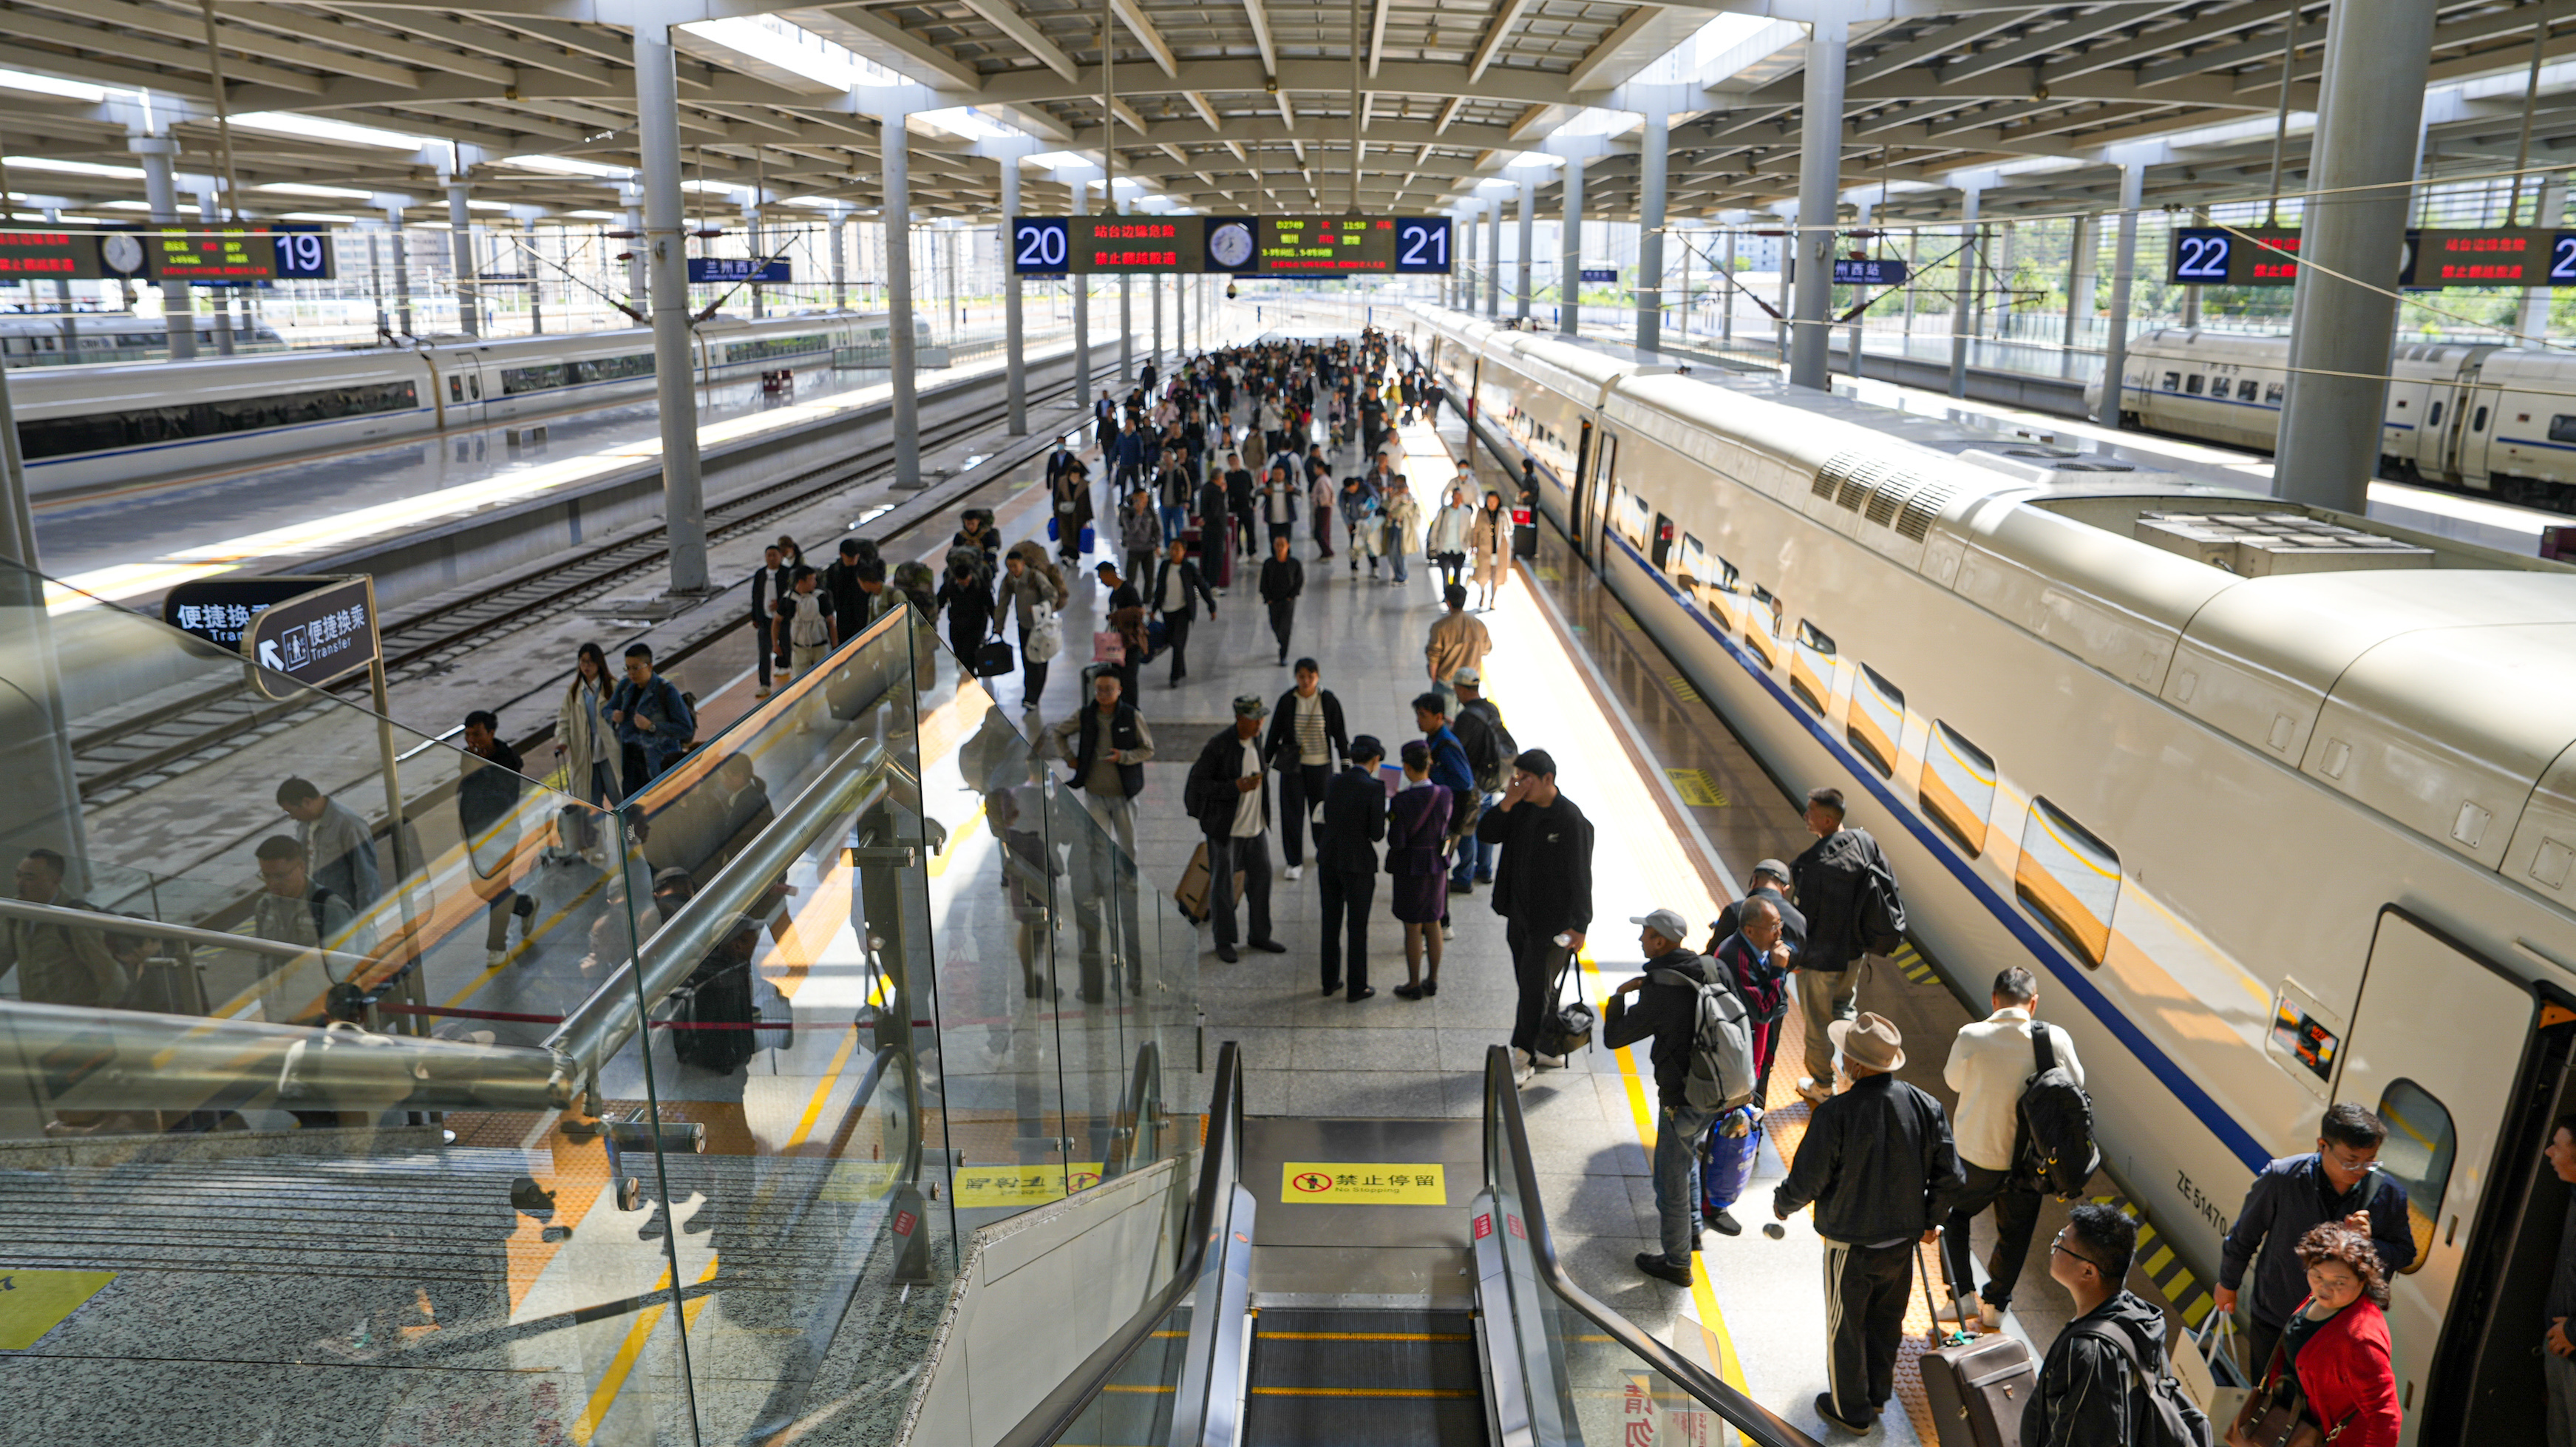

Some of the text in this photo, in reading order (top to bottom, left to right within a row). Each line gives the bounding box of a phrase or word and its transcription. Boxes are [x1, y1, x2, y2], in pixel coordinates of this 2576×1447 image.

[1017, 226, 1067, 265] 20
[1094, 225, 1175, 238] 站台边缘危险
[1401, 226, 1446, 265] 21
[276, 233, 322, 271] 19
[1095, 251, 1177, 265] 禁止翻越股道
[1835, 262, 1880, 277] 州西站
[2178, 237, 2229, 276] 22
[307, 603, 365, 646] 便捷换乘
[310, 636, 352, 662] Transfer
[1335, 1174, 1435, 1187] 禁止停留
[2177, 1169, 2233, 1237] ZE 51470
